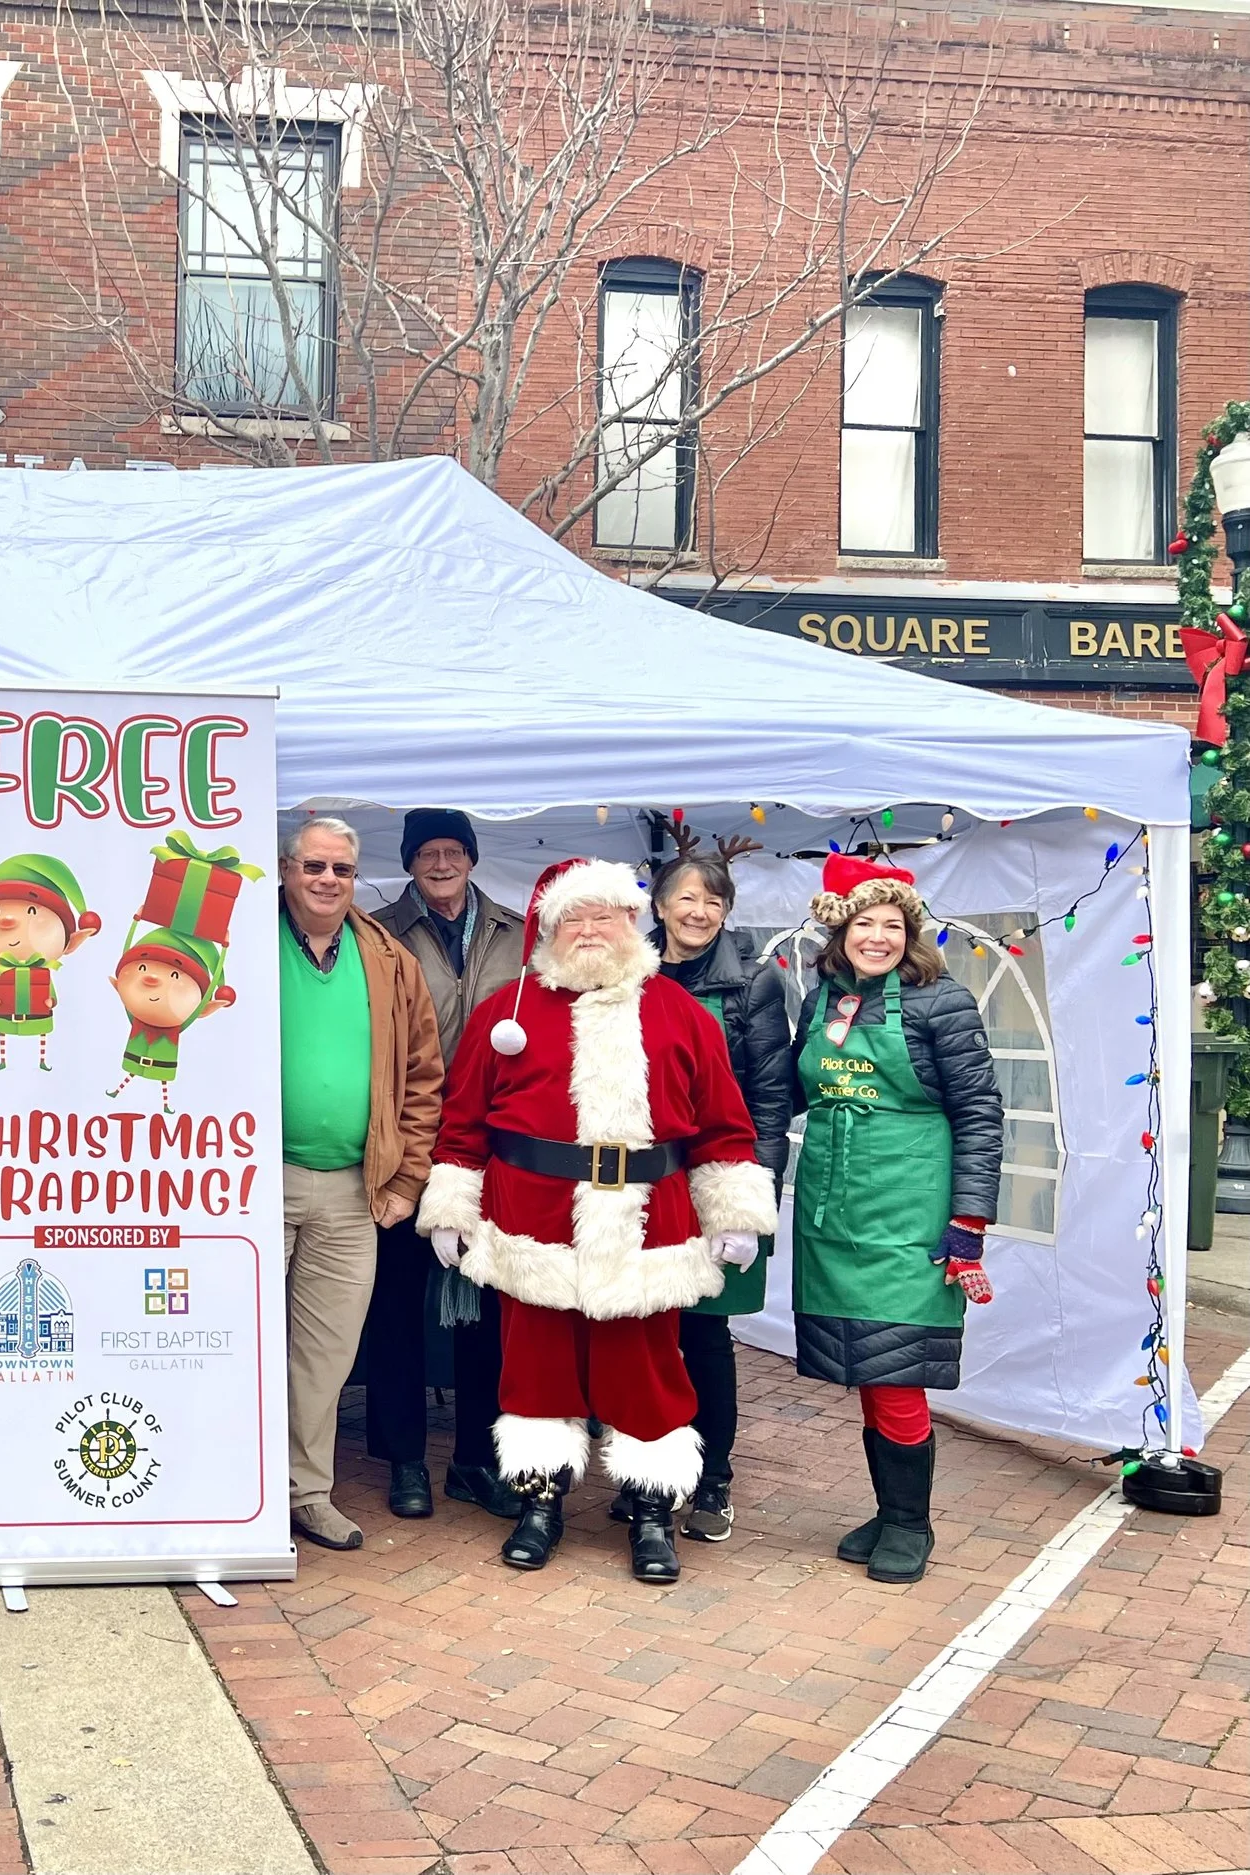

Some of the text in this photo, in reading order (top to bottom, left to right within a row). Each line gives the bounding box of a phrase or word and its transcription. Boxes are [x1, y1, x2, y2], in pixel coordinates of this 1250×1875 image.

[798, 613, 991, 655] SQUARE
[820, 1057, 874, 1073] Pilot Club
[837, 1073, 852, 1086] of
[858, 1085, 879, 1099] Co.
[43, 1227, 171, 1247] SPONSORED BY
[25, 1277, 33, 1349] HISTORIC
[101, 1331, 233, 1349] FIRST BAPTIST
[129, 1358, 204, 1371] GALLATIN
[54, 1392, 163, 1435] PILOT CLUB OF
[81, 1421, 135, 1447] PILOT
[81, 1451, 135, 1478] INTERNATIONAL
[54, 1457, 162, 1508] SUMNER COUNTY
